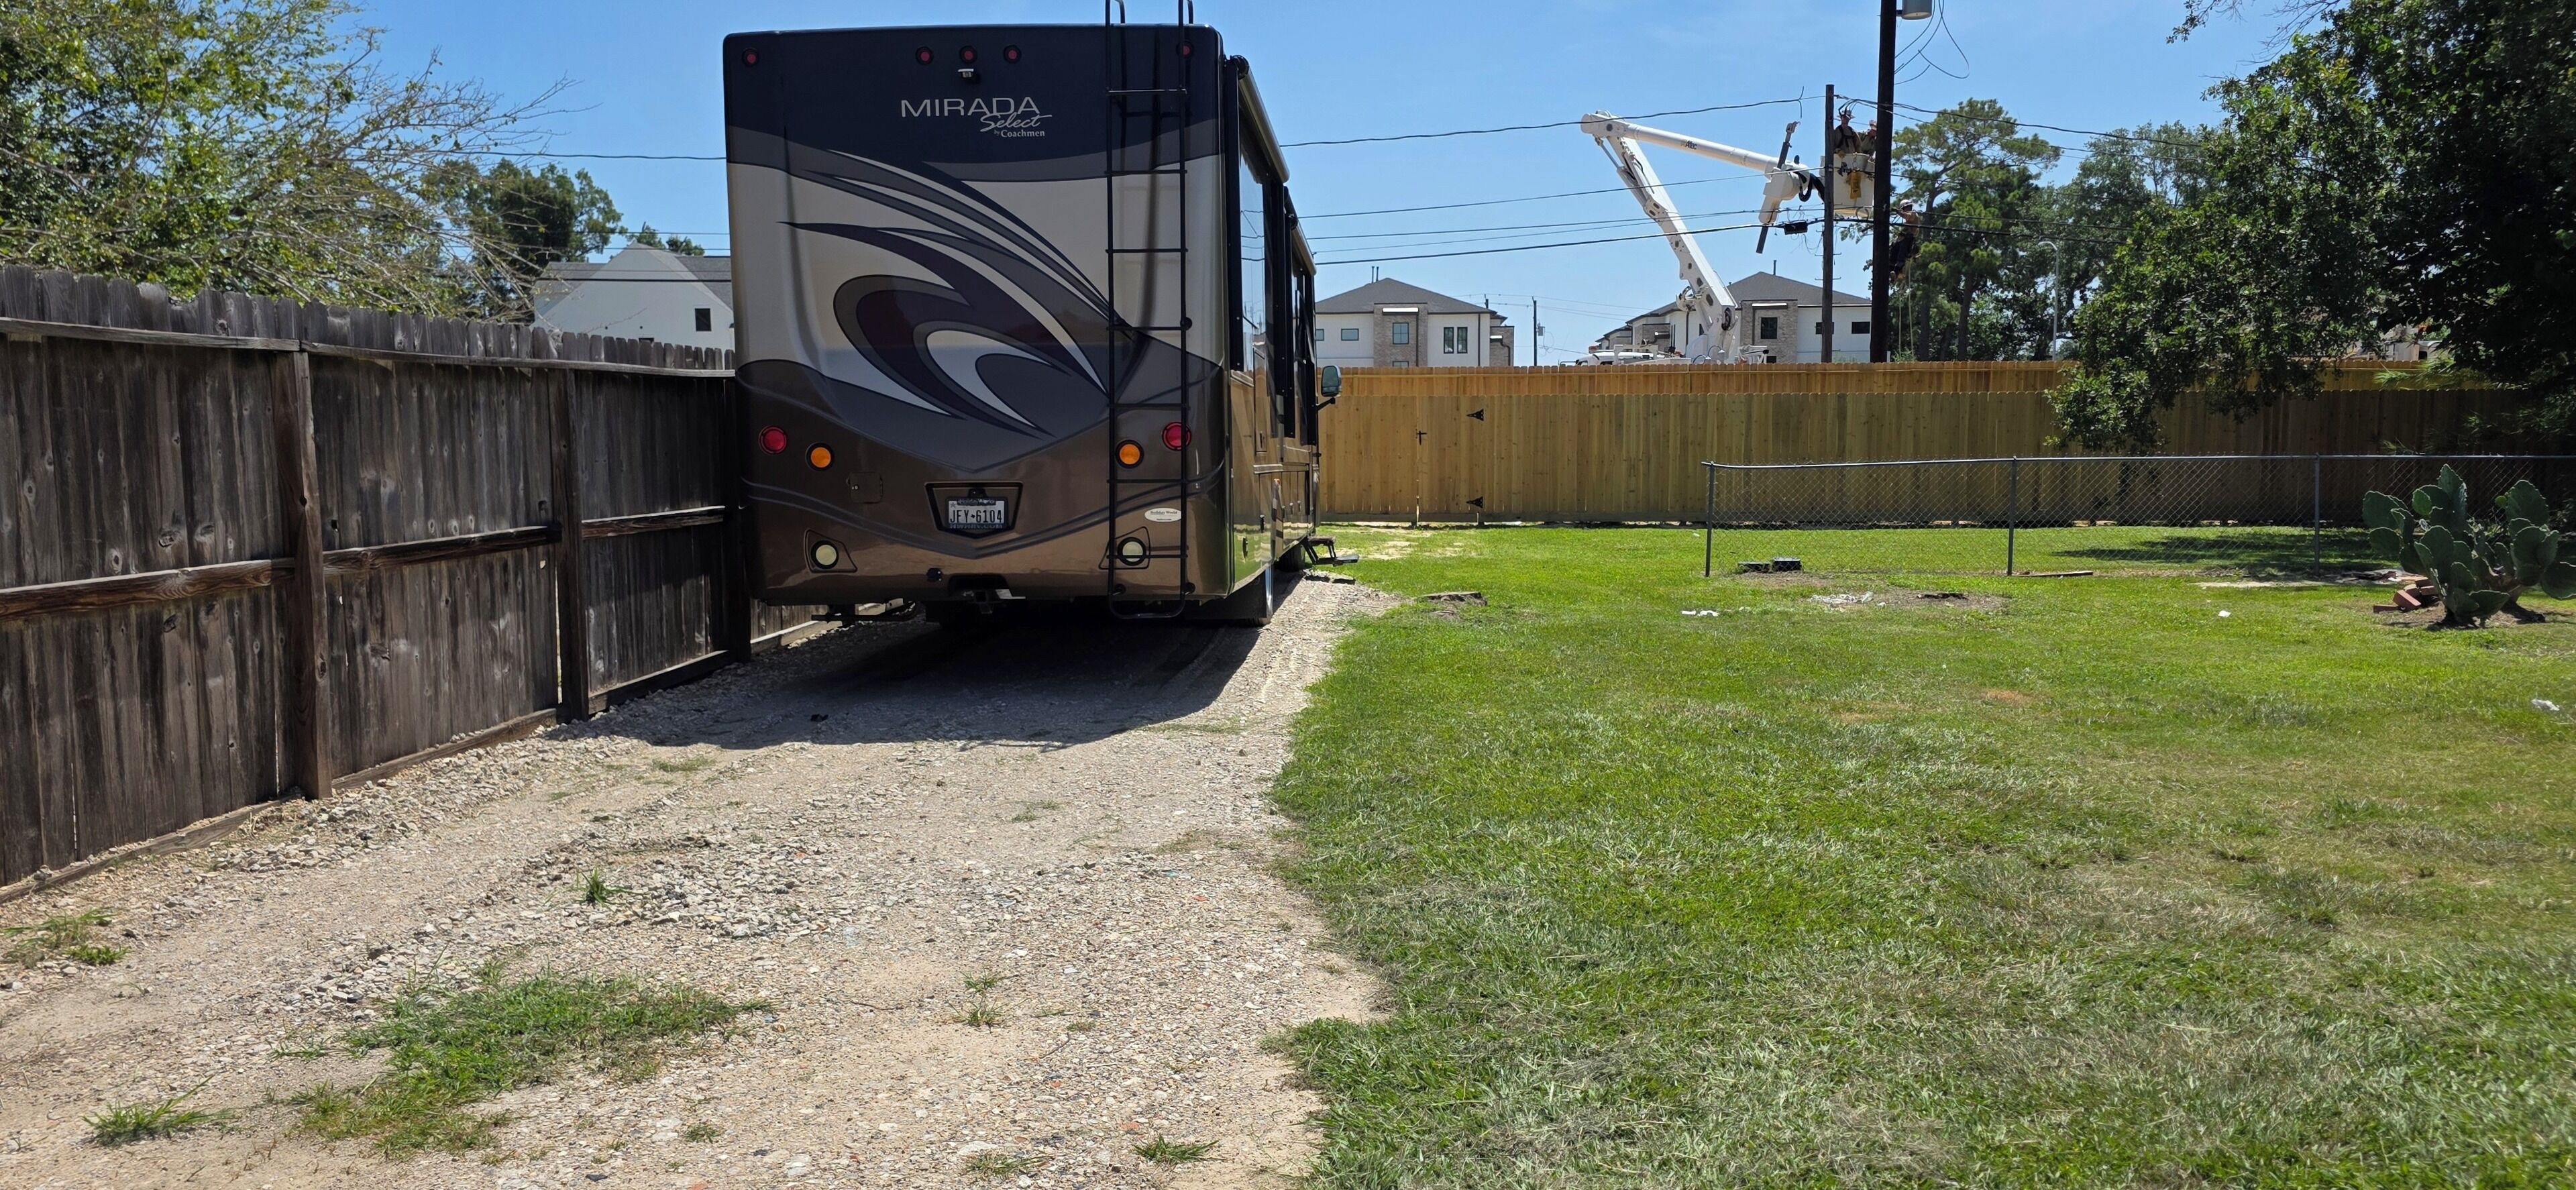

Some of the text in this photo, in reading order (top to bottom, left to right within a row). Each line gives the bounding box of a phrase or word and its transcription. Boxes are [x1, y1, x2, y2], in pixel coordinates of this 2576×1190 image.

[901, 97, 1040, 117] MIRADA
[979, 112, 1053, 132] Select
[1000, 129, 1046, 138] Coachmen
